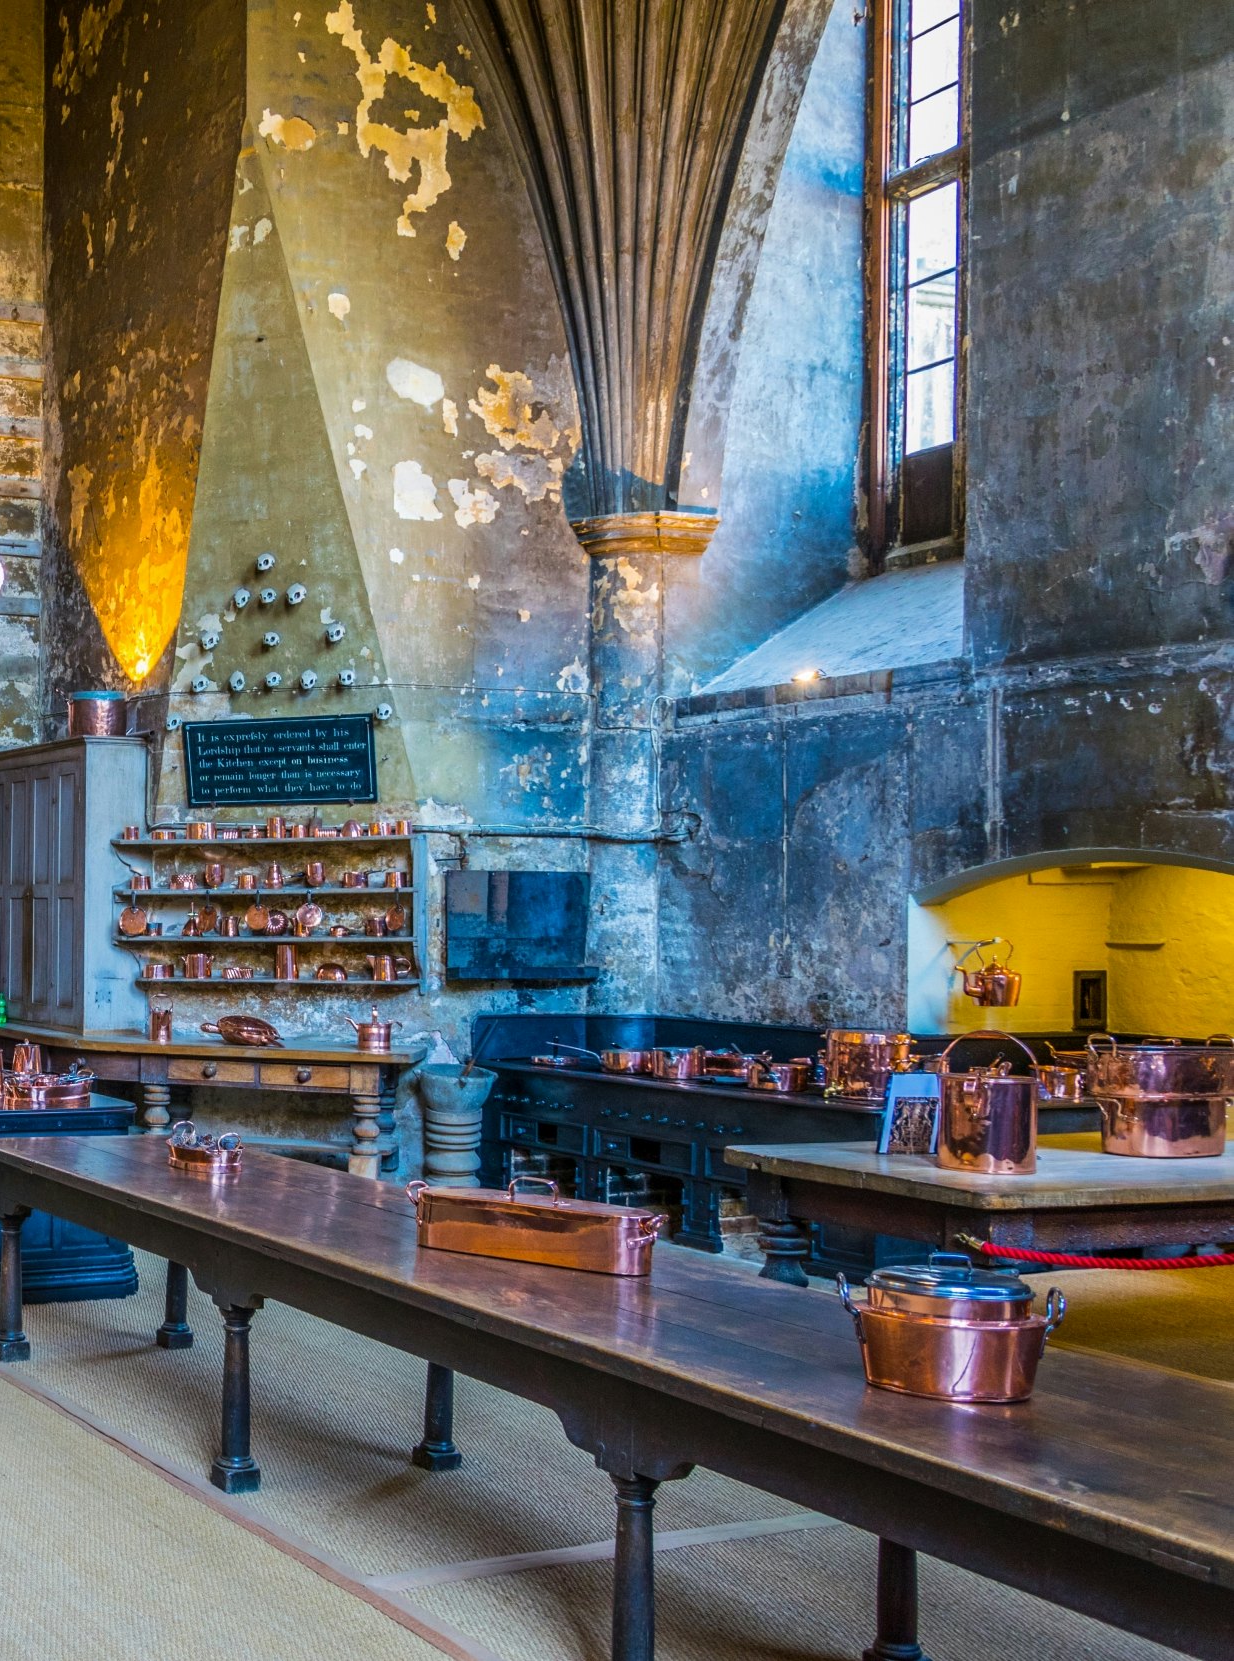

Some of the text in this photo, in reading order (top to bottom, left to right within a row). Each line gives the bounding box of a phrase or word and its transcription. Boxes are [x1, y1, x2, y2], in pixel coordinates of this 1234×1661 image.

[197, 732, 206, 743] It
[211, 732, 220, 742] is
[273, 729, 310, 739] ordered
[315, 729, 327, 739] by
[333, 727, 350, 737] his
[198, 746, 241, 756] Lordship
[244, 744, 261, 754] that
[278, 743, 315, 752] servants
[319, 742, 339, 751] shall
[343, 742, 366, 750] enter
[199, 759, 213, 769] the
[217, 758, 254, 768] Kitchen
[258, 758, 287, 768] except
[307, 755, 349, 765] business
[214, 772, 244, 781] remain
[249, 771, 277, 781] longer
[281, 770, 300, 779] than
[305, 769, 312, 778] is
[316, 769, 361, 778] necessary
[215, 786, 251, 797] perform
[257, 785, 279, 793] what
[284, 783, 304, 794] they
[309, 783, 331, 792] have
[336, 782, 345, 790] to
[350, 781, 362, 790] do
